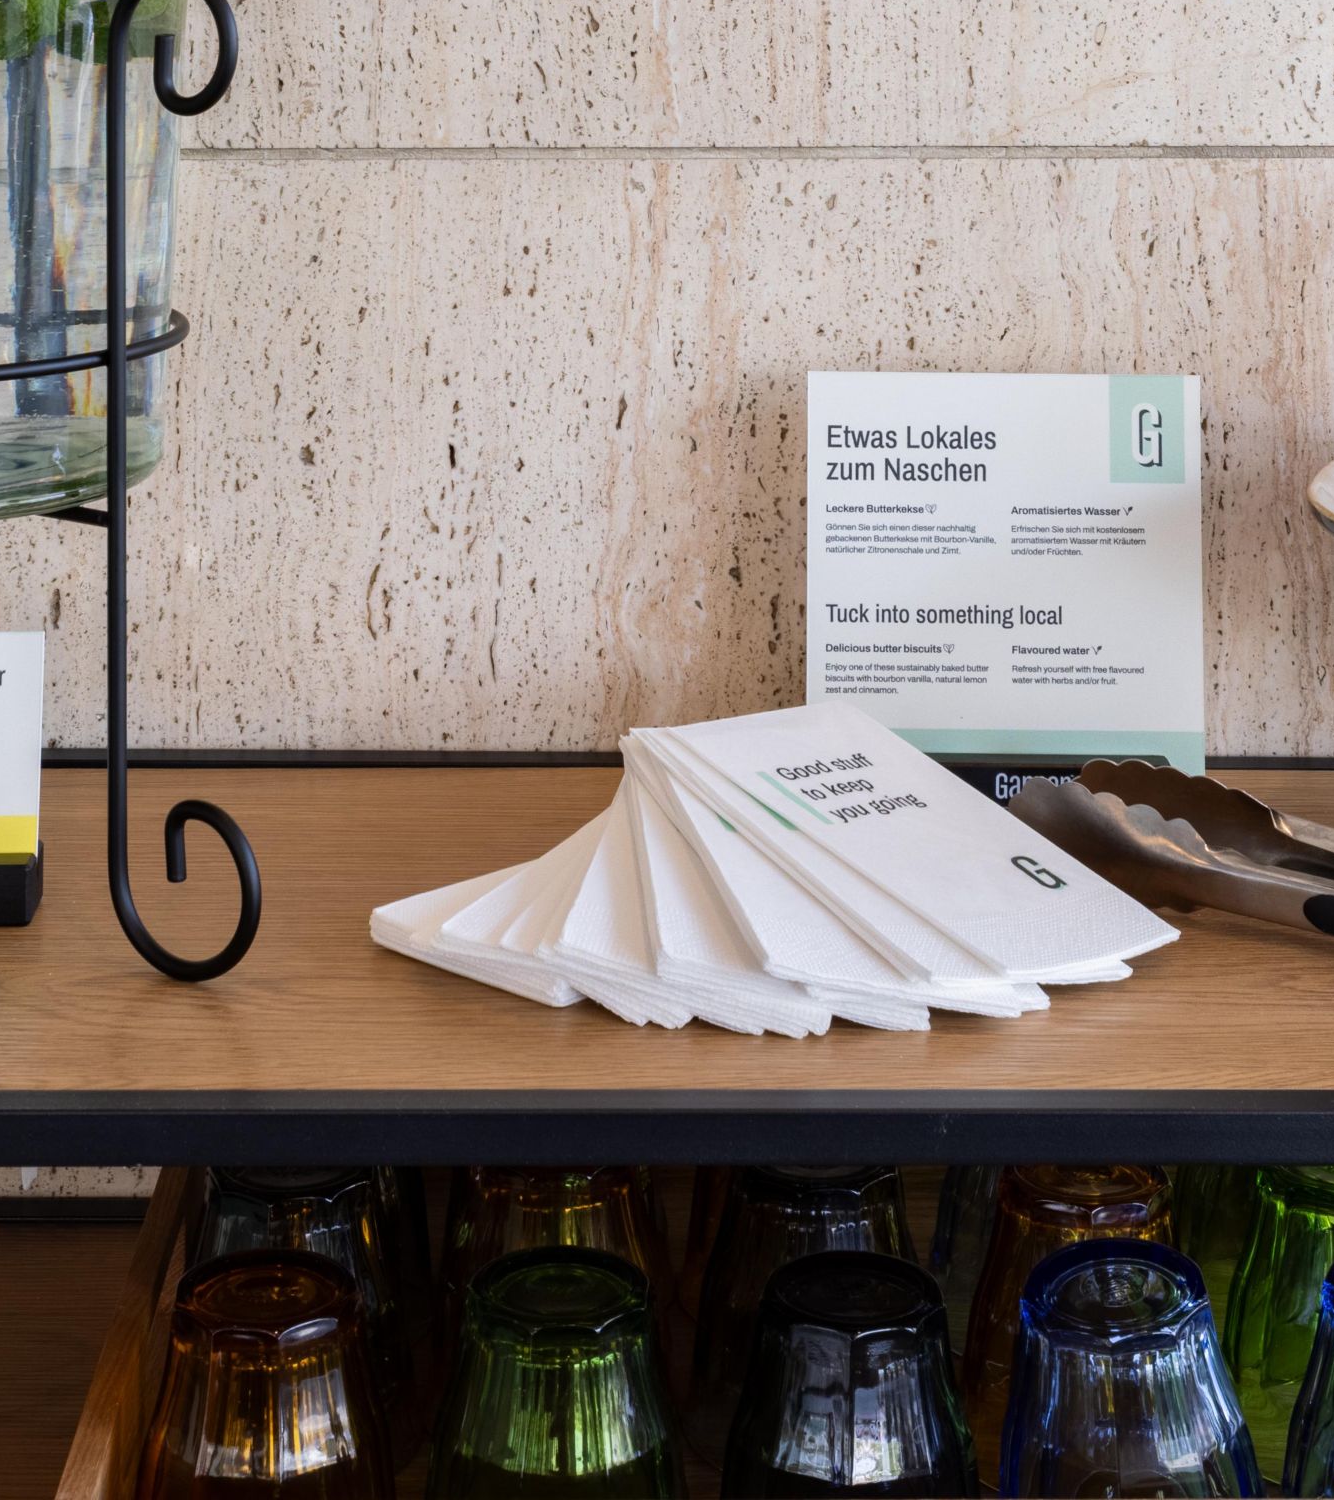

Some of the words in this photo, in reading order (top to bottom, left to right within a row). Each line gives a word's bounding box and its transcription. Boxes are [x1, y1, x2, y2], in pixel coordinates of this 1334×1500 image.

[828, 425, 897, 448] Etwas
[907, 425, 996, 449] Lokales
[827, 463, 874, 480] zum
[885, 457, 986, 482] Naschen
[826, 503, 864, 514] Leckere
[867, 504, 924, 514] Butterkekse
[1011, 505, 1082, 516] Aromatisiertes
[1084, 506, 1120, 517] Wasser
[859, 523, 870, 532] Sie
[872, 523, 887, 532] sich
[889, 523, 910, 532] einen
[912, 523, 935, 532] dieser
[1011, 524, 1050, 534] Erfrischen
[1052, 525, 1064, 534] Sie
[1066, 525, 1081, 534] sich
[1083, 526, 1095, 534] mit
[1097, 526, 1145, 535] kostenlosem
[826, 534, 872, 544] gebackenen
[874, 534, 919, 543] Butterkekse
[921, 535, 932, 543] mit
[1011, 536, 1068, 545] aromatisiertem
[1070, 537, 1098, 545] Wasser
[1100, 537, 1111, 546] mit
[867, 545, 923, 555] Zitronenschale
[925, 546, 939, 555] und
[1011, 547, 1045, 556] und/oder
[826, 604, 869, 623] Tuck
[876, 604, 909, 623] into
[916, 605, 1014, 629] something
[1020, 605, 1062, 625] local
[826, 643, 871, 653] Delicious
[873, 643, 902, 654] butter
[904, 643, 942, 654] biscuits
[1012, 644, 1060, 655] Flavoured
[1063, 646, 1090, 656] water
[826, 662, 847, 673] Enjoy
[849, 664, 863, 672] one
[865, 662, 872, 672] of
[874, 663, 895, 672] these
[897, 663, 940, 674] sustainably
[942, 664, 965, 673] baked
[967, 664, 989, 673] butter
[1012, 664, 1042, 673] Refresh
[1044, 665, 1074, 675] yourself
[1075, 665, 1091, 673] with
[1093, 665, 1107, 674] free
[1109, 665, 1144, 675] flavoured
[825, 674, 855, 683] biscuits
[856, 674, 872, 683] with
[874, 674, 905, 683] bourbon
[907, 674, 933, 684] vanilla,
[935, 675, 961, 684] natural
[963, 675, 987, 684] lemon
[1012, 676, 1032, 685] water
[1034, 676, 1050, 685] with
[1052, 676, 1073, 685] herbs
[1075, 676, 1099, 685] and/or
[1101, 676, 1119, 685] fruit.
[825, 686, 841, 694] zest
[843, 685, 857, 694] and
[859, 685, 898, 695] cinnamon.
[776, 759, 833, 781] Good
[830, 752, 873, 772] stuff
[800, 787, 827, 801] to
[821, 777, 874, 797] keep
[829, 804, 871, 823] you
[869, 793, 927, 815] going
